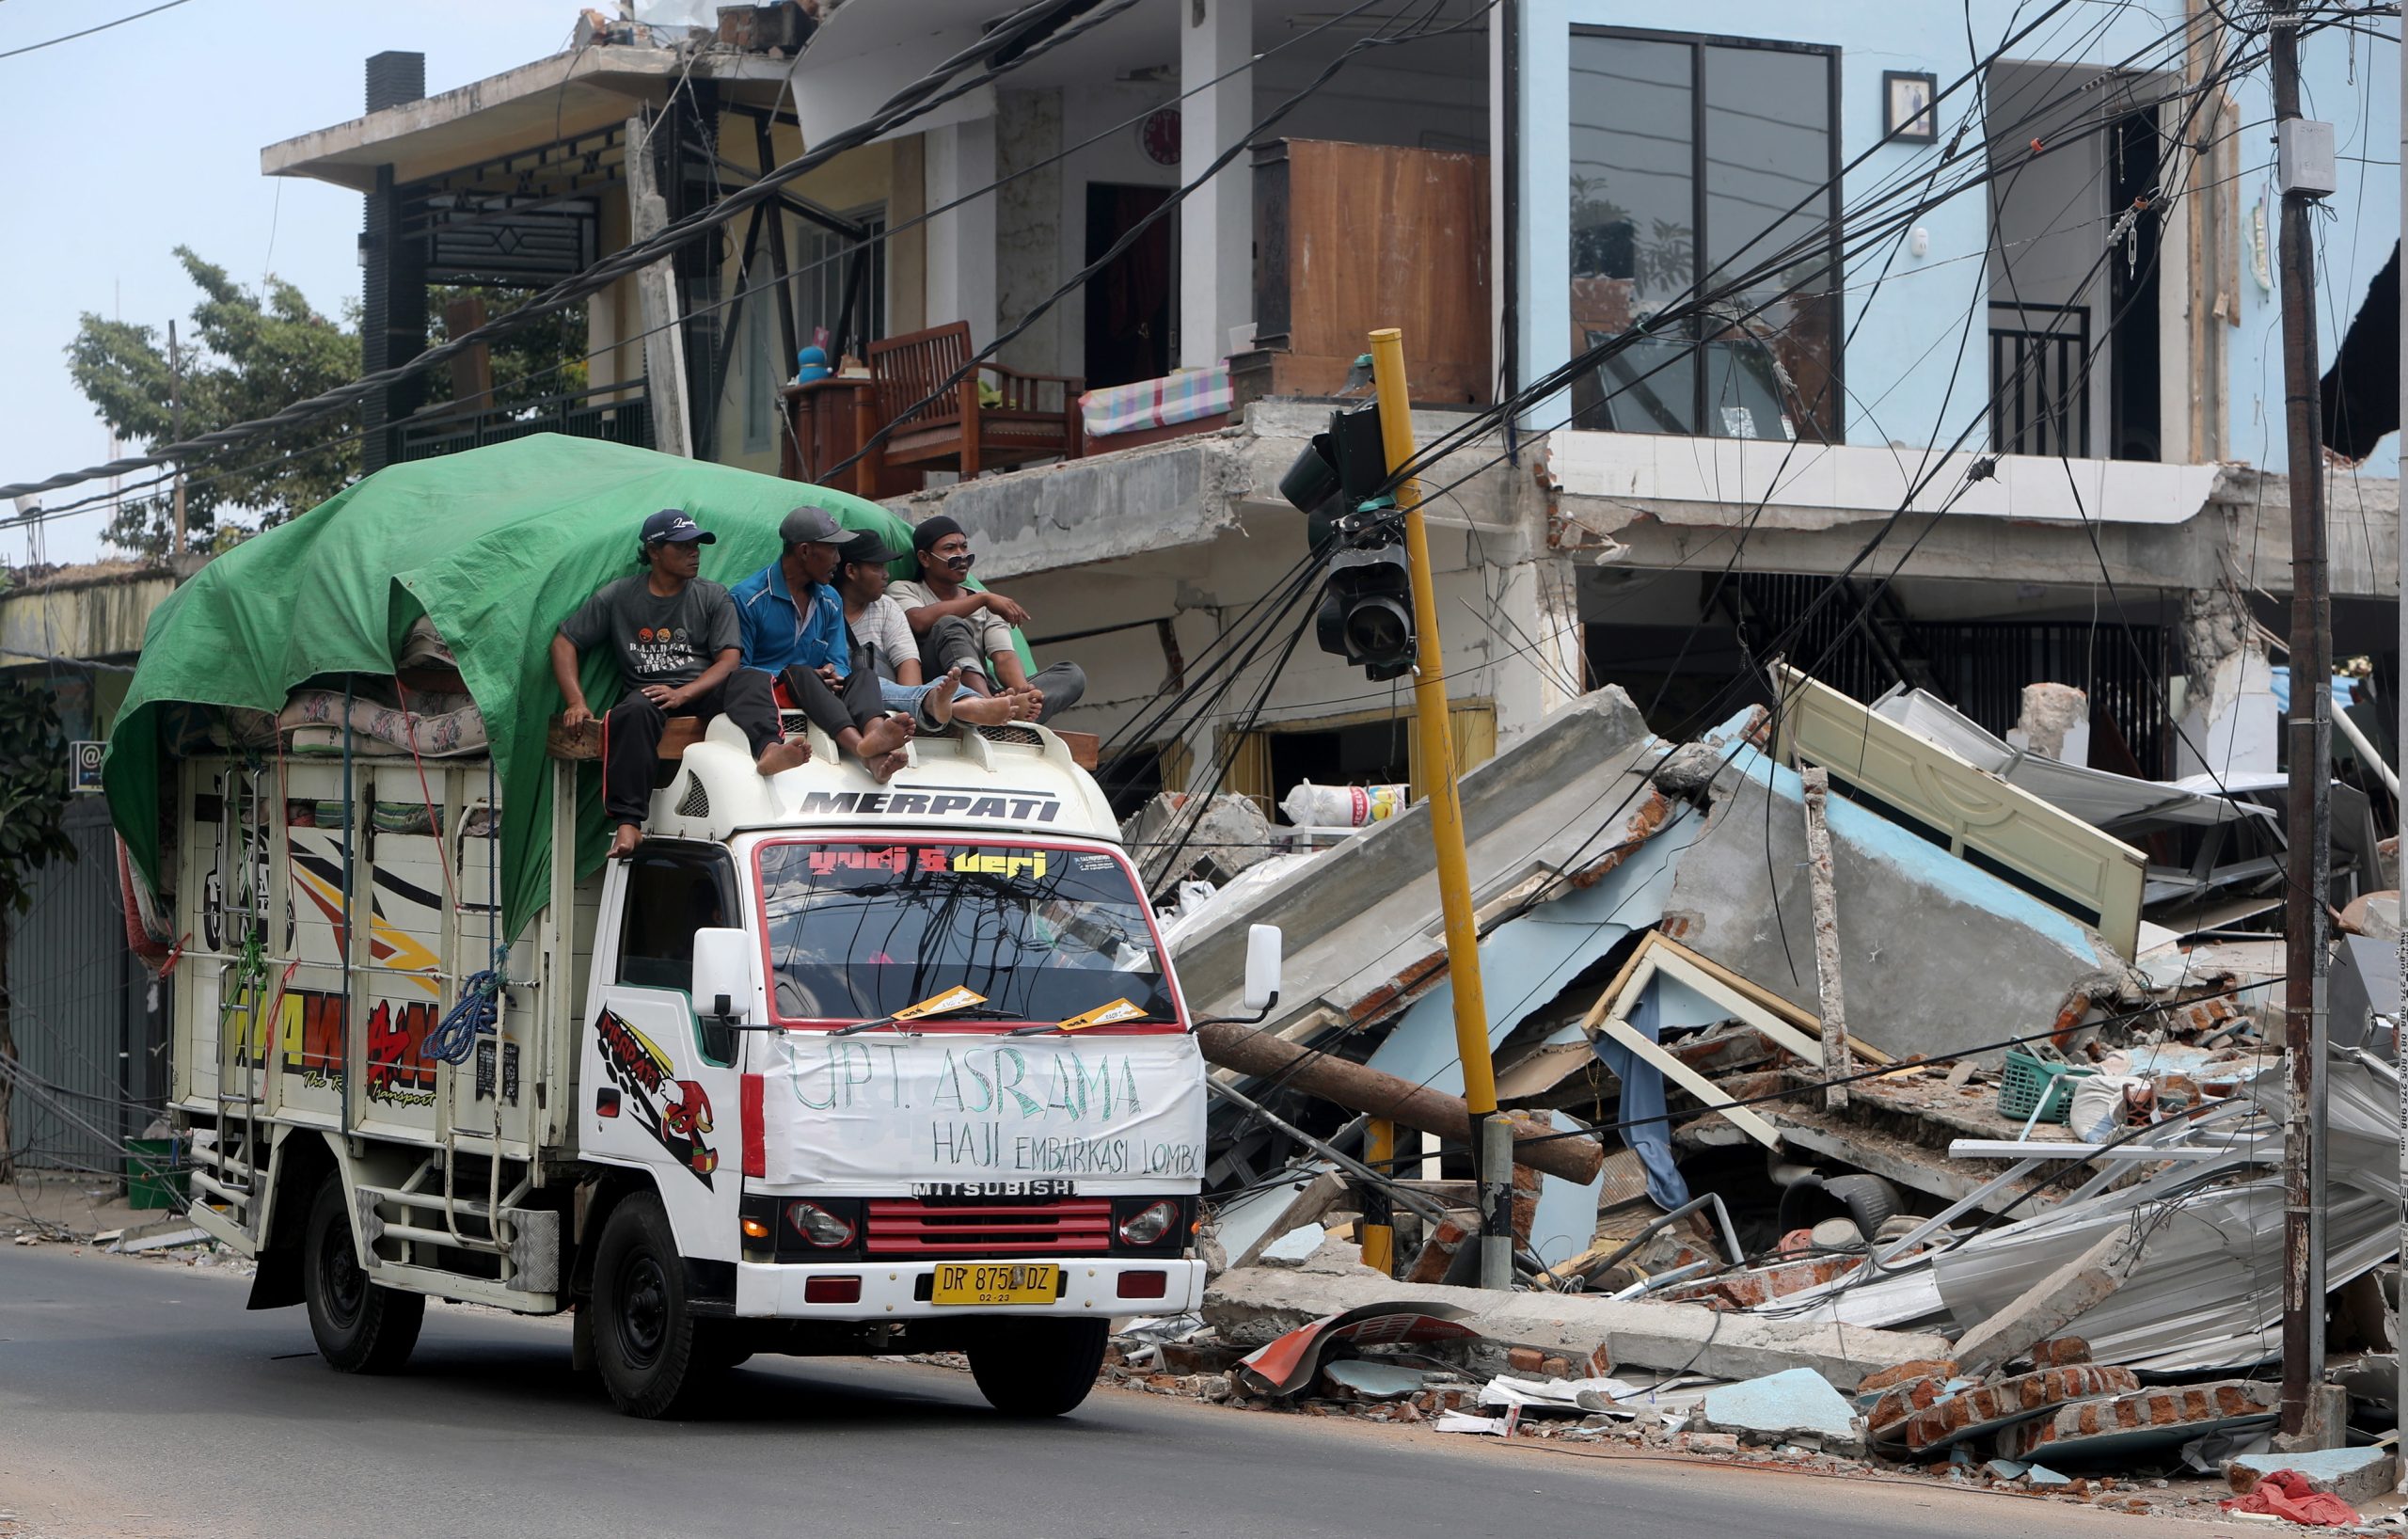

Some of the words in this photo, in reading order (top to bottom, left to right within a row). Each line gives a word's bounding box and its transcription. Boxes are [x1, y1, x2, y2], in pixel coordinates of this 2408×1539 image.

[800, 792, 1061, 822] MERPATI
[303, 1071, 327, 1089] The
[789, 1041, 910, 1110] UPT.
[932, 1047, 1141, 1122] ASRAMA
[932, 1120, 1000, 1168] HAJI
[1015, 1136, 1129, 1175] EMBARKASI
[912, 1180, 1078, 1197] MITSUBISHI
[943, 1267, 966, 1290] DR
[1026, 1267, 1049, 1290] DZ
